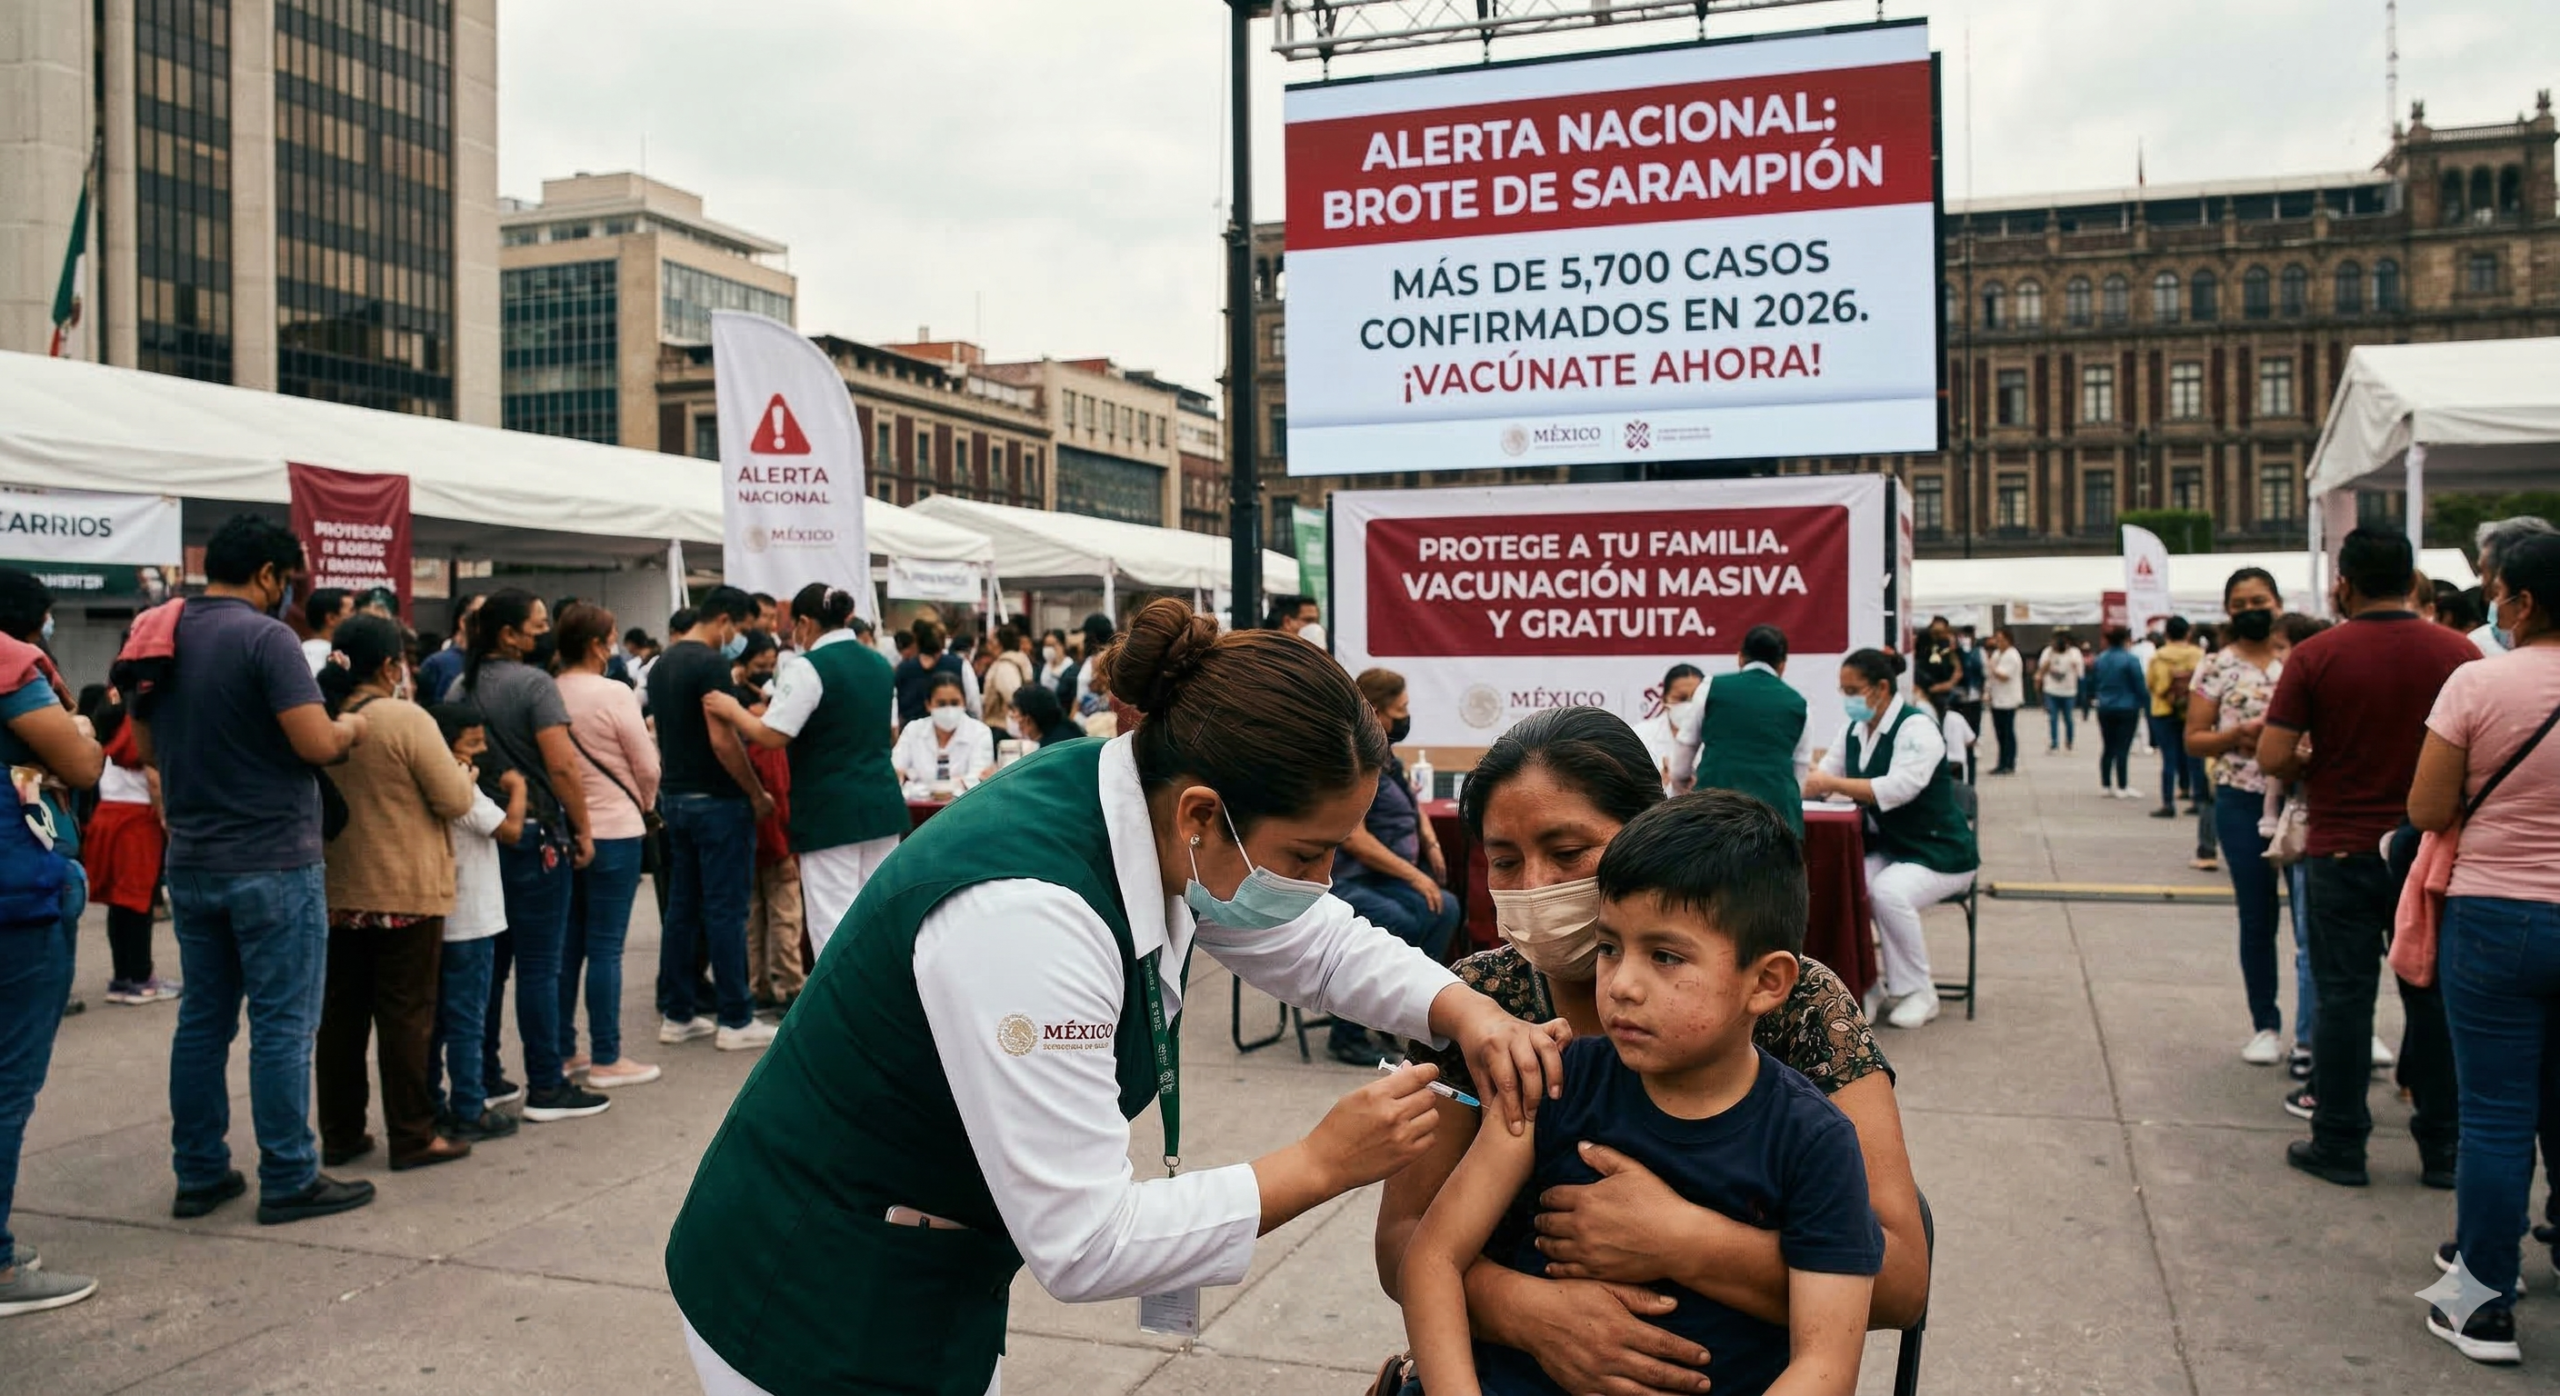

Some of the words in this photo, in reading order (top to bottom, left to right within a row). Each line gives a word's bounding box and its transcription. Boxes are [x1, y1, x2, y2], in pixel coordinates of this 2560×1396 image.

[1361, 117, 1545, 172] ALERTA
[1558, 92, 1837, 153] NACIONAL:
[1322, 175, 1480, 230] BROTE
[1492, 170, 1559, 216] DE
[1571, 138, 1884, 210] SARAMPIÓN
[1393, 258, 1479, 300] MÁS
[1494, 259, 1547, 292] DE
[1560, 250, 1671, 294] 5,700
[1684, 239, 1829, 282] CASOS
[1360, 301, 1670, 350] CONFIRMADOS
[1684, 296, 1740, 331] EN
[1753, 289, 1870, 328] 2026.
[1404, 351, 1637, 403] ¡VACÚNATE
[1651, 343, 1821, 384] AHORA!
[1533, 424, 1601, 443] MÉXICO
[738, 466, 830, 484] ALERTA
[738, 490, 832, 504] NACIONAL
[0, 511, 112, 538] ARRIOS
[771, 526, 834, 541] MÉXICO
[1419, 533, 1560, 562] PROTEGE
[1568, 534, 1592, 559] A
[1599, 531, 1640, 557] TU
[1650, 529, 1789, 557] FAMILIA.
[1402, 563, 1646, 600] VACUNACIÓN
[1658, 564, 1807, 596] MASIVA
[1488, 610, 1509, 639] Y
[1520, 607, 1716, 638] GRATUITA.
[1510, 687, 1605, 708] MÉXICO
[1043, 1019, 1114, 1040] MÉXICO
